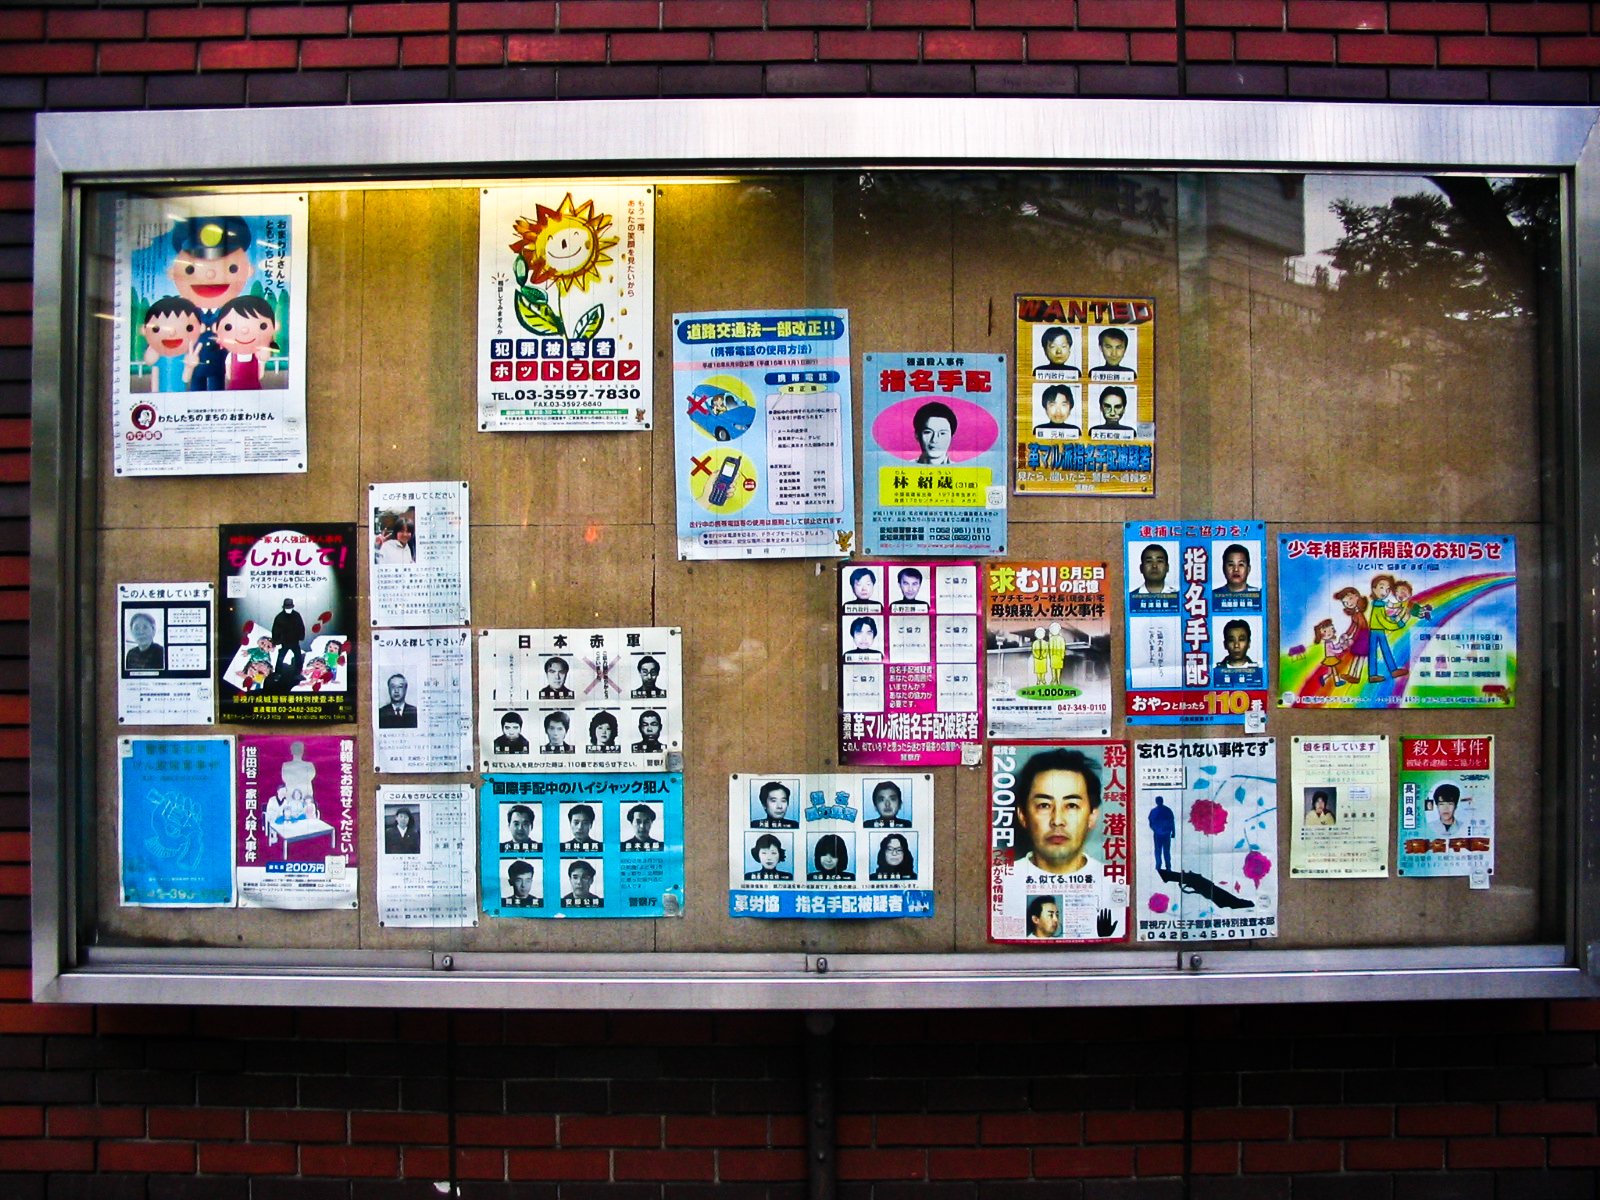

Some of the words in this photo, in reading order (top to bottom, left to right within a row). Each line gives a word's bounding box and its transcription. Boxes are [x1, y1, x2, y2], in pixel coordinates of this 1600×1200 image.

[627, 200, 635, 297] あなたの笑顔を見たいから
[1018, 299, 1152, 324] WANTED
[686, 320, 835, 341] 道路交通法一部改正!!
[495, 341, 611, 356] 犯罪被害者
[495, 362, 637, 378] ホットライン
[880, 369, 992, 393] 指名手配
[226, 545, 348, 569] もしかして!
[1287, 540, 1501, 560] 少年相談所開設のお知らせ
[989, 566, 1057, 594] 求む!!
[1059, 565, 1105, 580] 8月5日
[1060, 580, 1099, 593] の記憶
[1184, 546, 1210, 686] 指名手配
[518, 633, 641, 649] 日本赤軍
[853, 712, 979, 741] 革マル派指名手配被疑者
[1139, 741, 1269, 759] 忘れられない事件です
[1412, 739, 1484, 756] 殺人事件
[492, 780, 670, 795] 国際手配中のハイジャック犯人
[245, 746, 257, 863] 世田谷一家四人殺人事件
[285, 862, 325, 873] 200万円
[734, 894, 780, 913] 革労協
[795, 894, 903, 914] 指名手配被疑者
